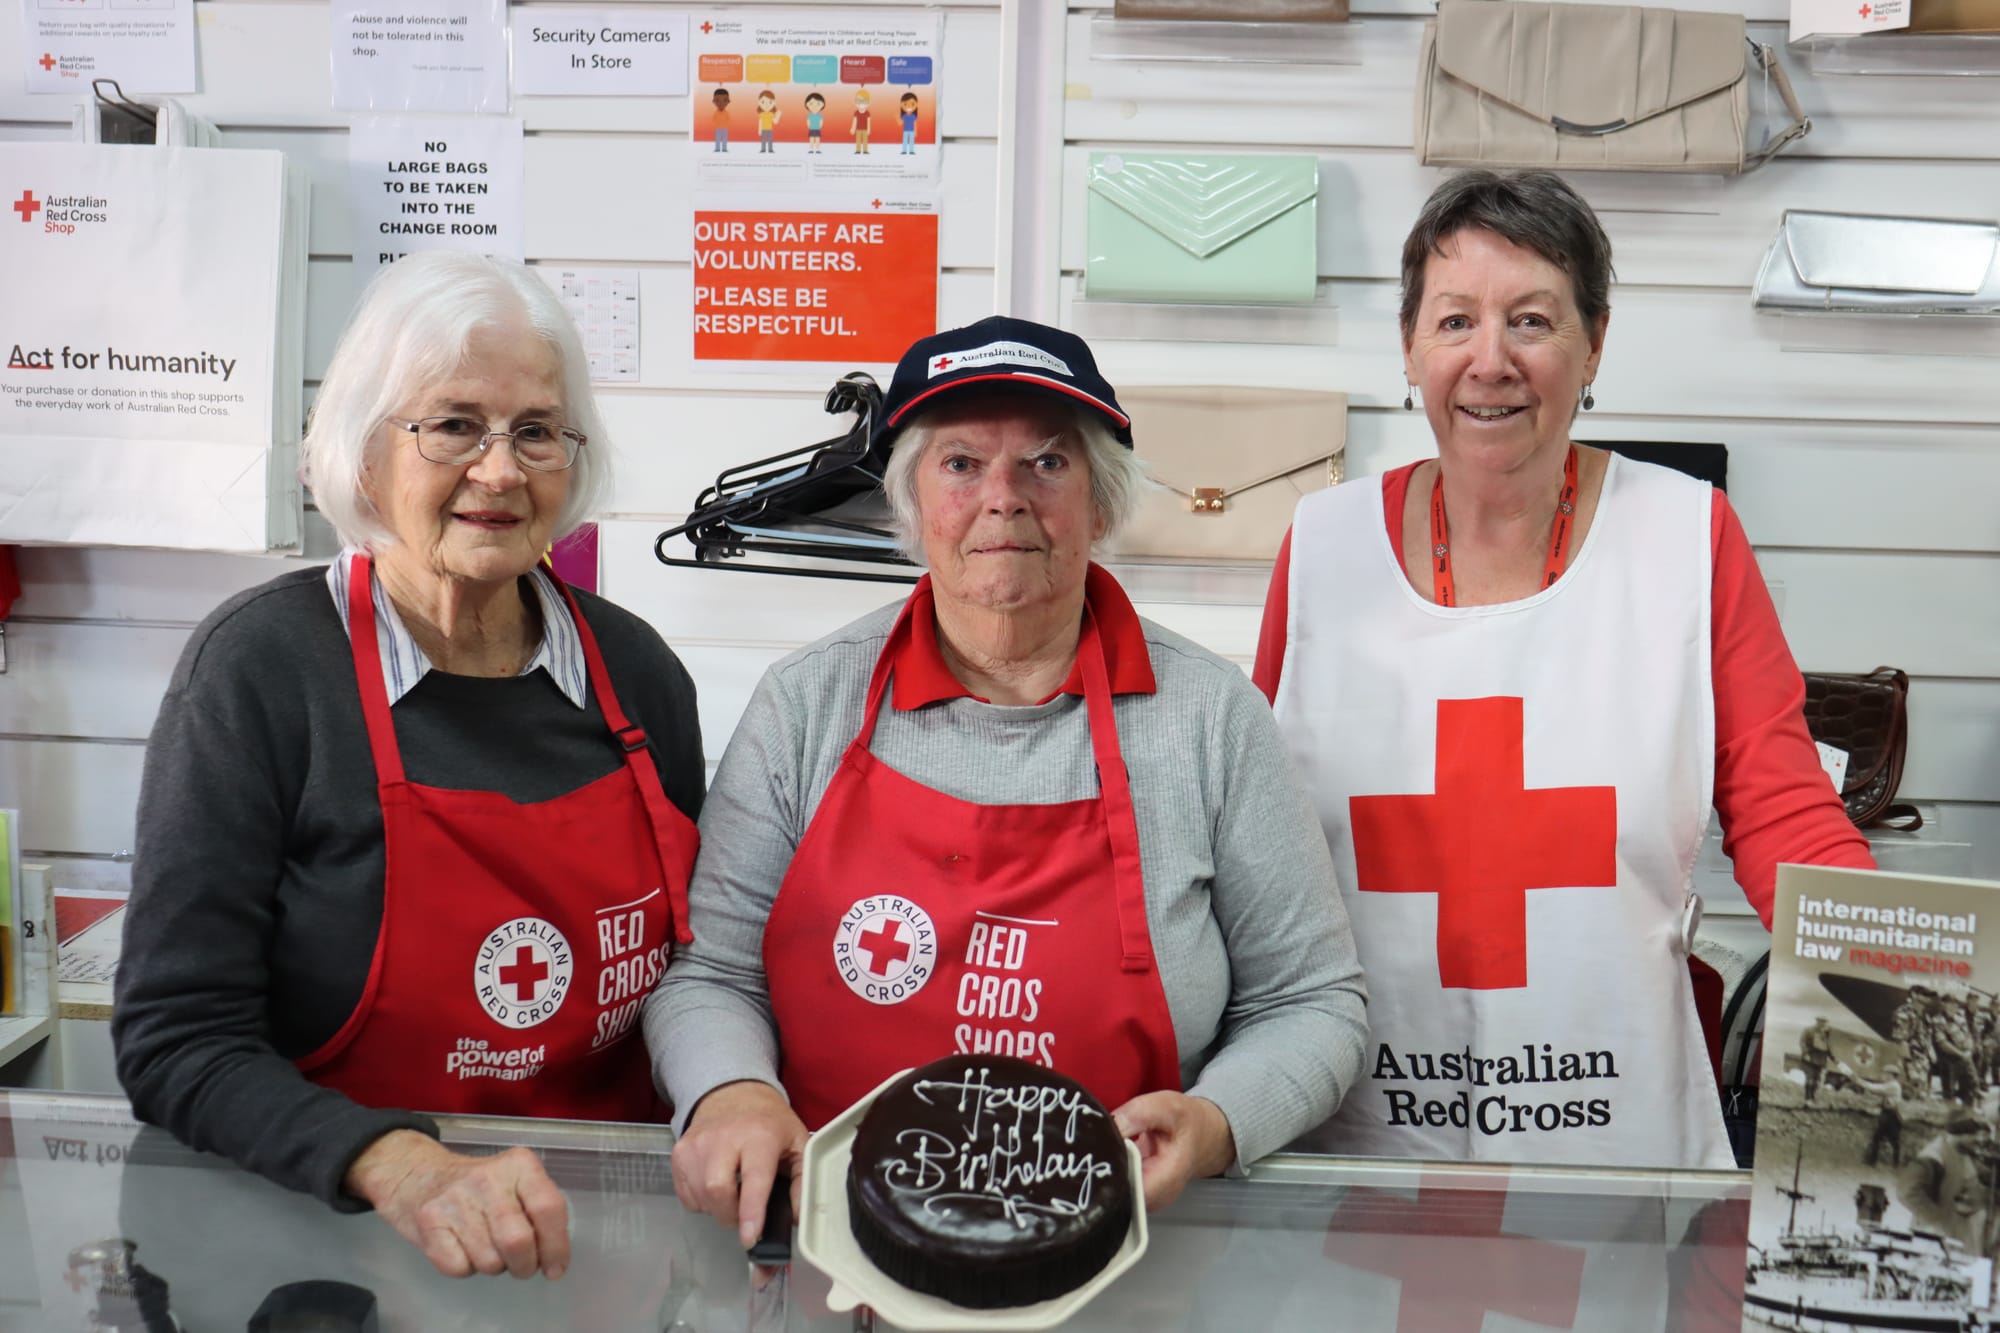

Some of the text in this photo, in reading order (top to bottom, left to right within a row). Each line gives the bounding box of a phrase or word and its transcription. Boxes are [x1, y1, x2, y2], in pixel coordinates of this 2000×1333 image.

[352, 14, 467, 25] Abuse and violence will
[352, 30, 464, 41] not be tolerated in this
[533, 28, 671, 45] Security Cameras
[771, 37, 784, 45] will
[785, 37, 807, 45] make
[828, 38, 844, 46] that
[898, 40, 912, 48] you
[352, 47, 379, 57] shop.
[572, 55, 632, 69] In Store
[843, 58, 866, 66] Heard
[890, 59, 908, 67] Safe
[60, 70, 79, 78] Shop
[425, 142, 447, 153] NO
[388, 162, 488, 174] LARGE BAGS
[384, 182, 488, 194] TO BE TAKEN
[46, 195, 107, 209] Australian
[402, 203, 475, 215] INTO THE
[46, 209, 107, 222] Red Cross
[44, 221, 75, 235] Shop
[379, 222, 498, 236] CHANGE ROOM
[695, 222, 884, 244] OUR STAFF ARE
[695, 250, 862, 272] VOLUNTEERS.
[695, 286, 827, 308] PLEASE BE
[695, 314, 858, 336] RESPECTFUL.
[8, 344, 237, 382] Act for humanity
[960, 348, 1016, 364] Australian
[1018, 349, 1038, 362] Red
[1, 383, 245, 404] Your purchase or donation in this shop supports
[15, 398, 32, 408] the
[35, 398, 83, 411] everyday
[86, 400, 111, 410] work
[114, 401, 124, 411] of
[127, 401, 175, 413] Australian
[177, 403, 197, 414] Red
[1798, 894, 1976, 934] international
[596, 909, 645, 961] RED
[842, 897, 933, 956] AUSTRALIAN
[1796, 916, 1974, 956] humanitarian
[478, 921, 569, 975] AUSTRALIAN
[965, 922, 1028, 970] RED
[1795, 937, 1972, 977] law magazine
[598, 941, 670, 1006] CROSS
[836, 941, 859, 984] RED
[865, 963, 928, 1001] CROSS
[480, 984, 509, 1020] RED
[517, 974, 567, 1025] CROSS
[956, 972, 1042, 1023] CROS
[455, 1037, 489, 1051] the
[953, 1023, 1056, 1069] SHOPS
[446, 1045, 545, 1073] power of
[1371, 1043, 1619, 1087] Australian
[458, 1062, 545, 1081] humanity
[913, 1068, 1103, 1143] Happy
[1382, 1089, 1612, 1136] Red Cross
[885, 1123, 1112, 1210] Birthday
